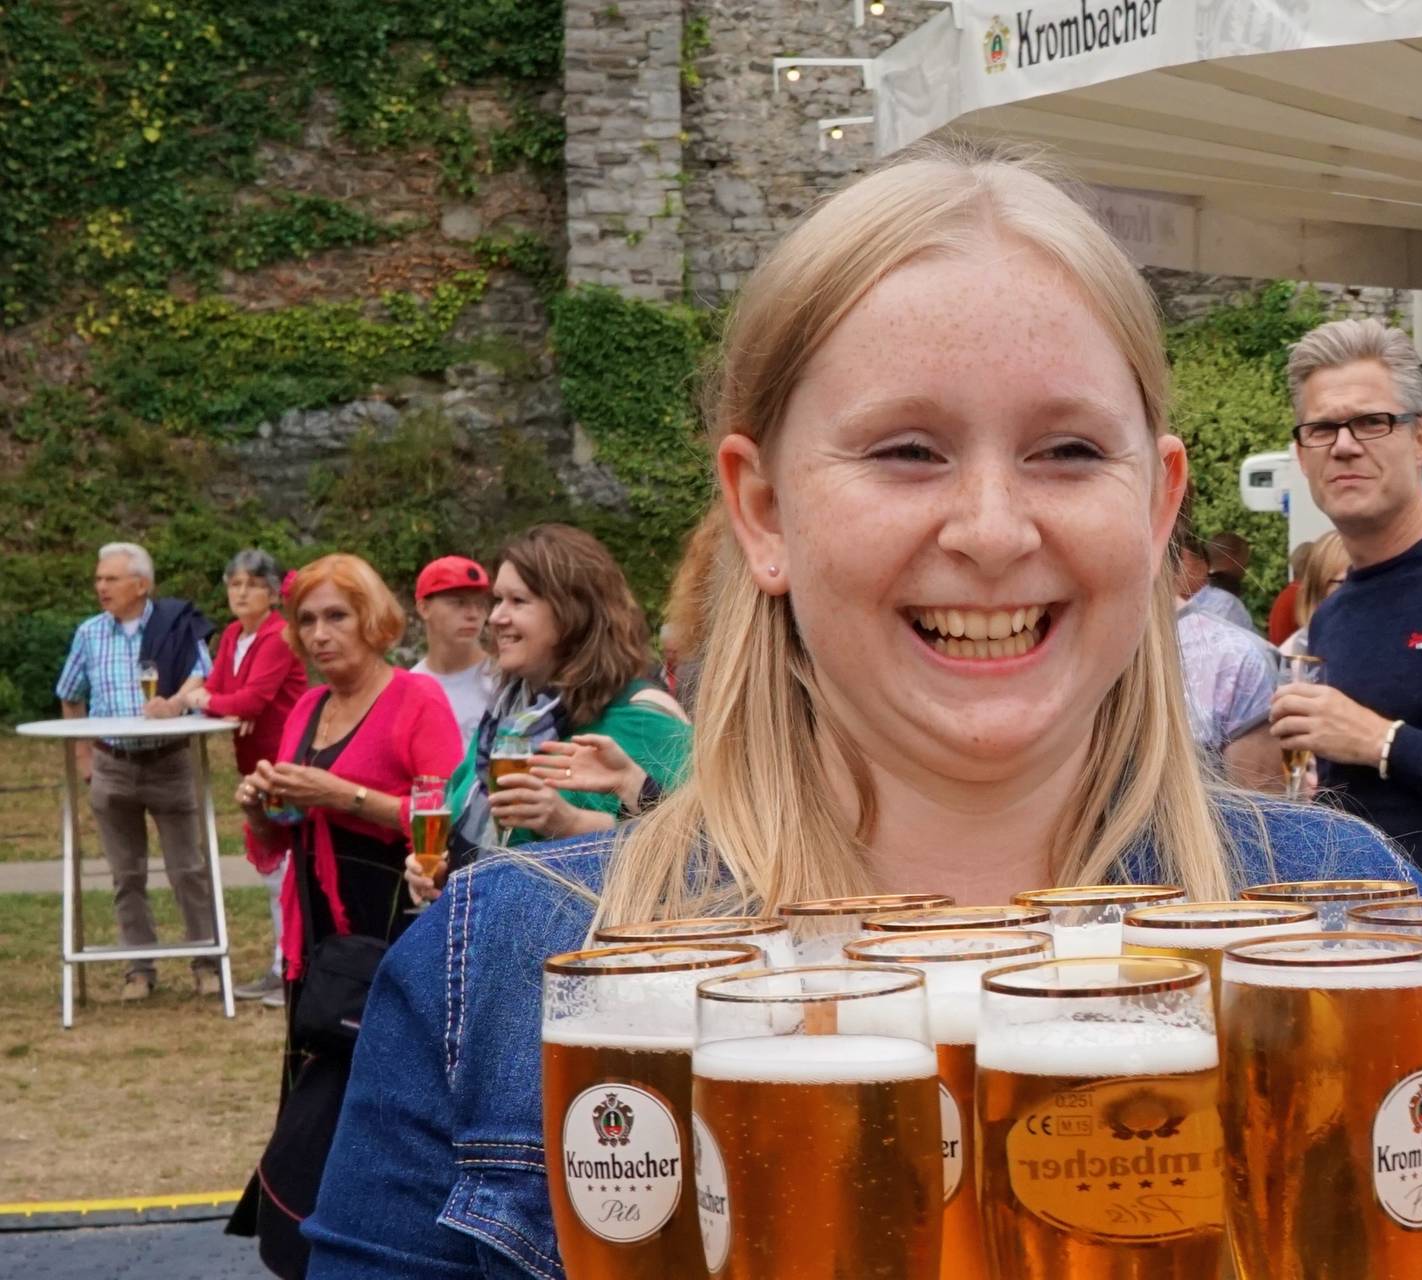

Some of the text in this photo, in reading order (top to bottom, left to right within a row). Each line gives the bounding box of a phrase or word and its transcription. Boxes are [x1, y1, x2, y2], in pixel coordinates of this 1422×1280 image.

[1017, 0, 1162, 68] Krombacher
[566, 1151, 679, 1179] Krombacher
[598, 1199, 641, 1223] Pils
